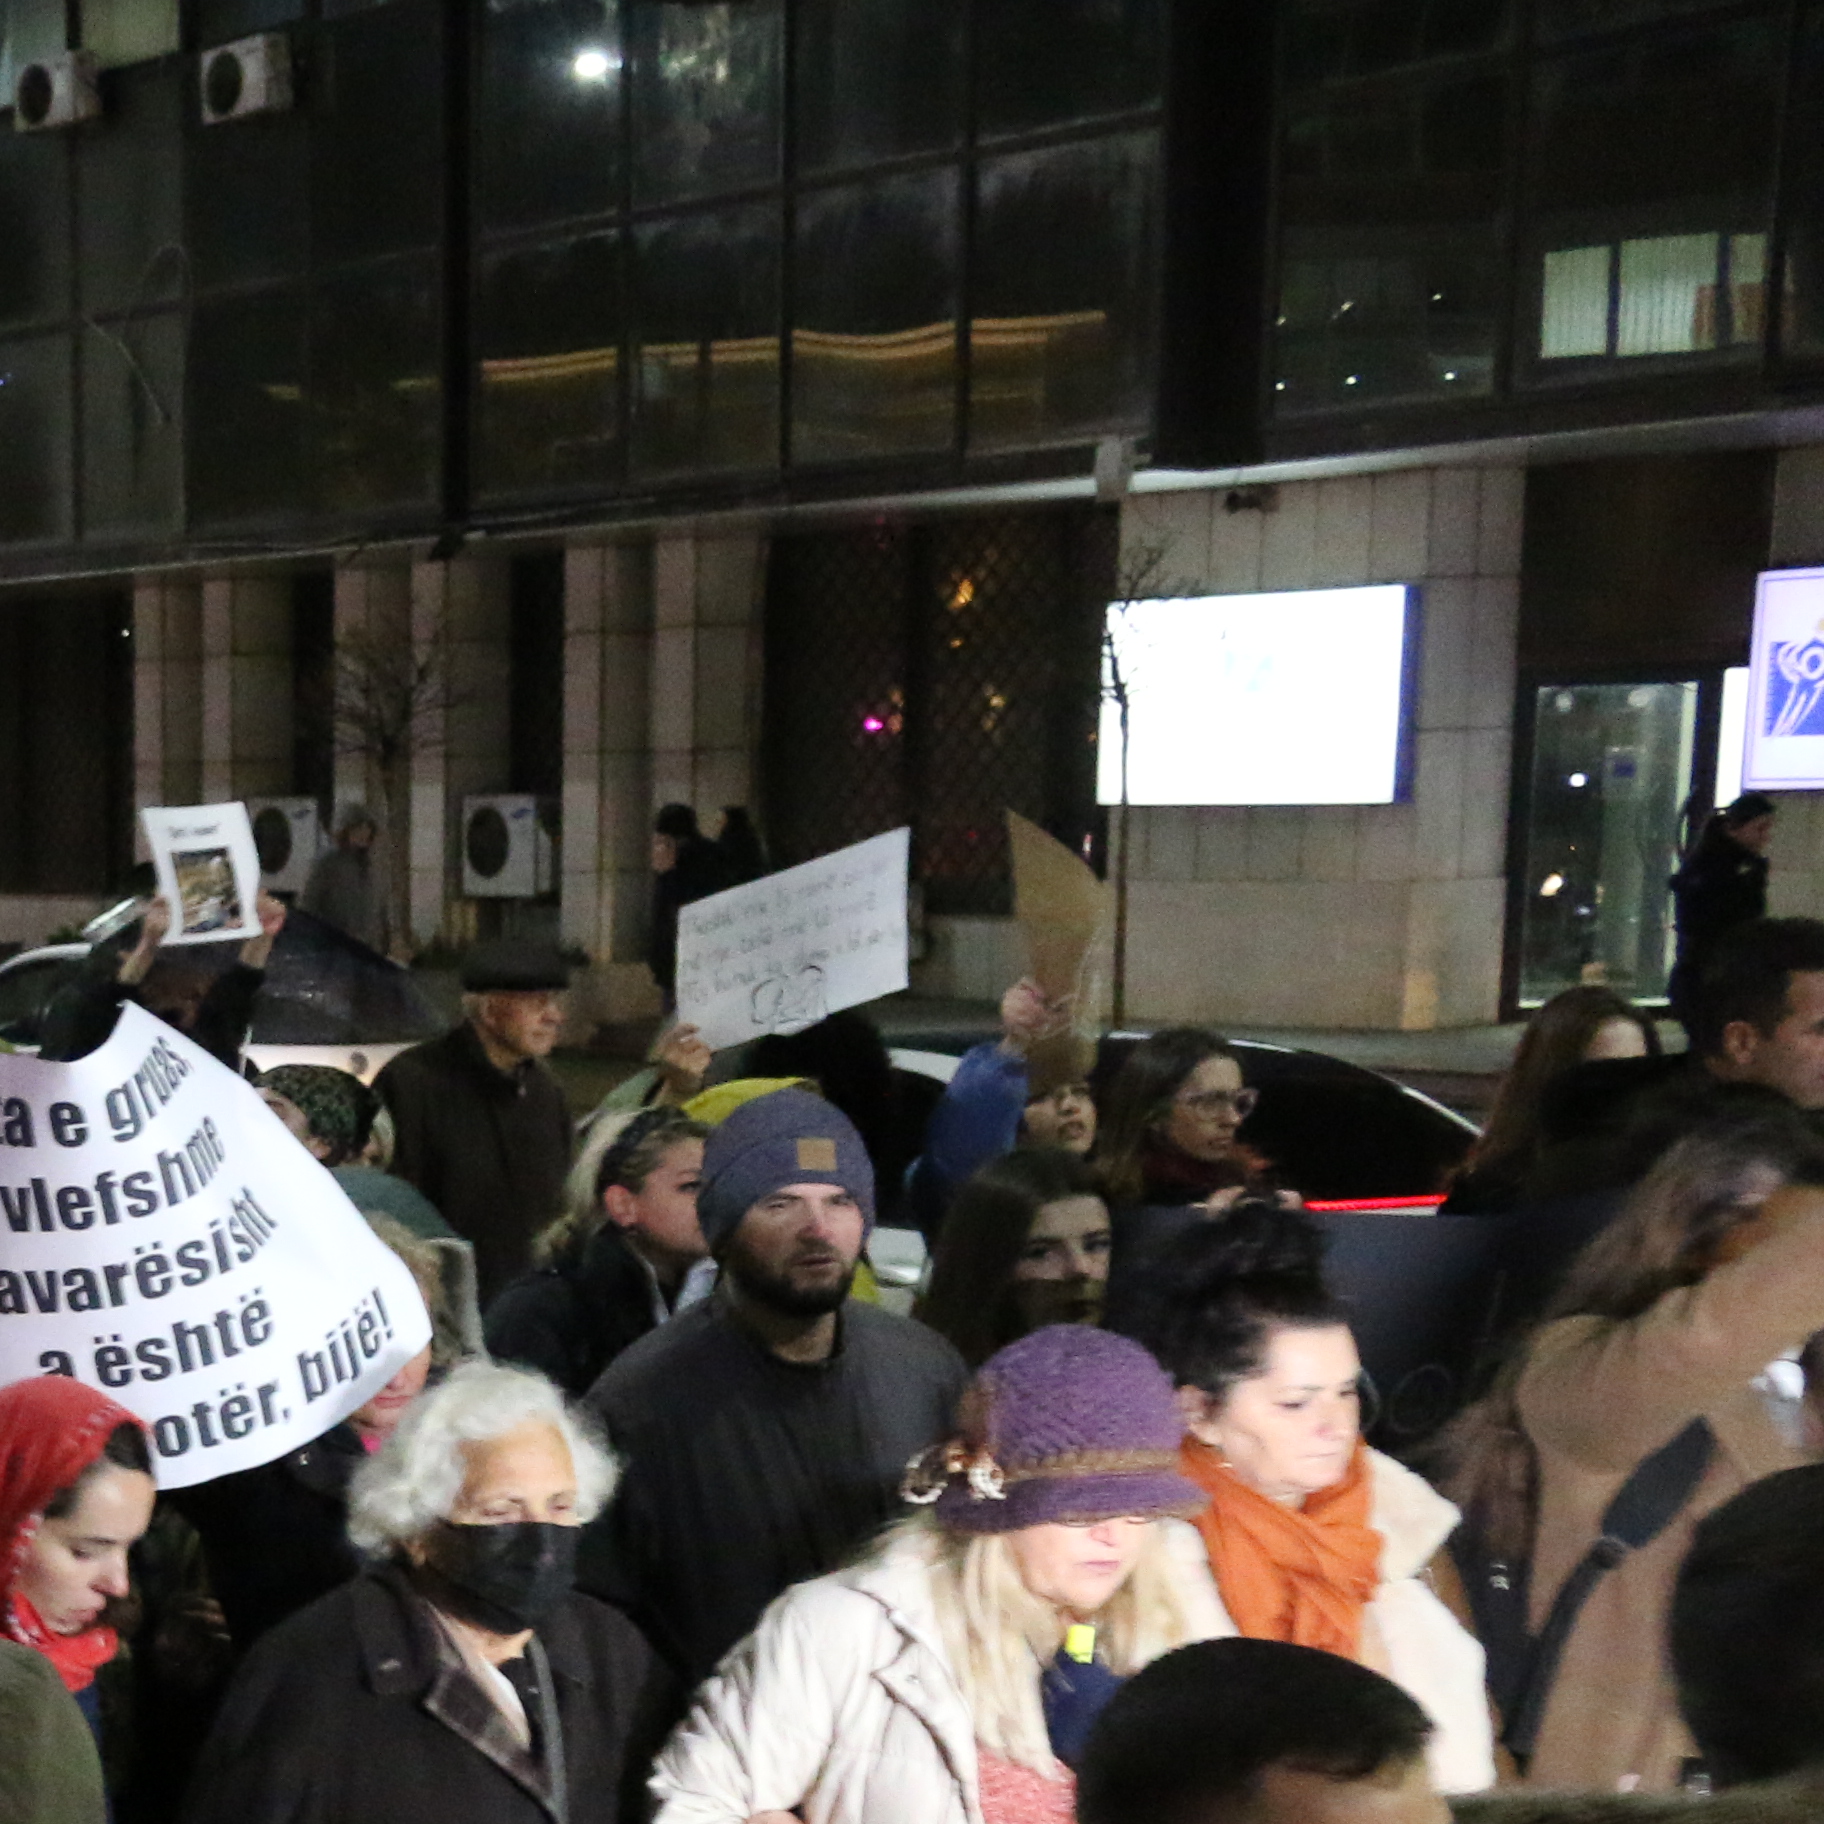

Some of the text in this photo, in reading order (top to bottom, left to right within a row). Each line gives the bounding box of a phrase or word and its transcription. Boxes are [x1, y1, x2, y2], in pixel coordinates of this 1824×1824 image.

[49, 1100, 89, 1148] e
[93, 1286, 275, 1389] është
[154, 1286, 396, 1459] otër, bijë!
